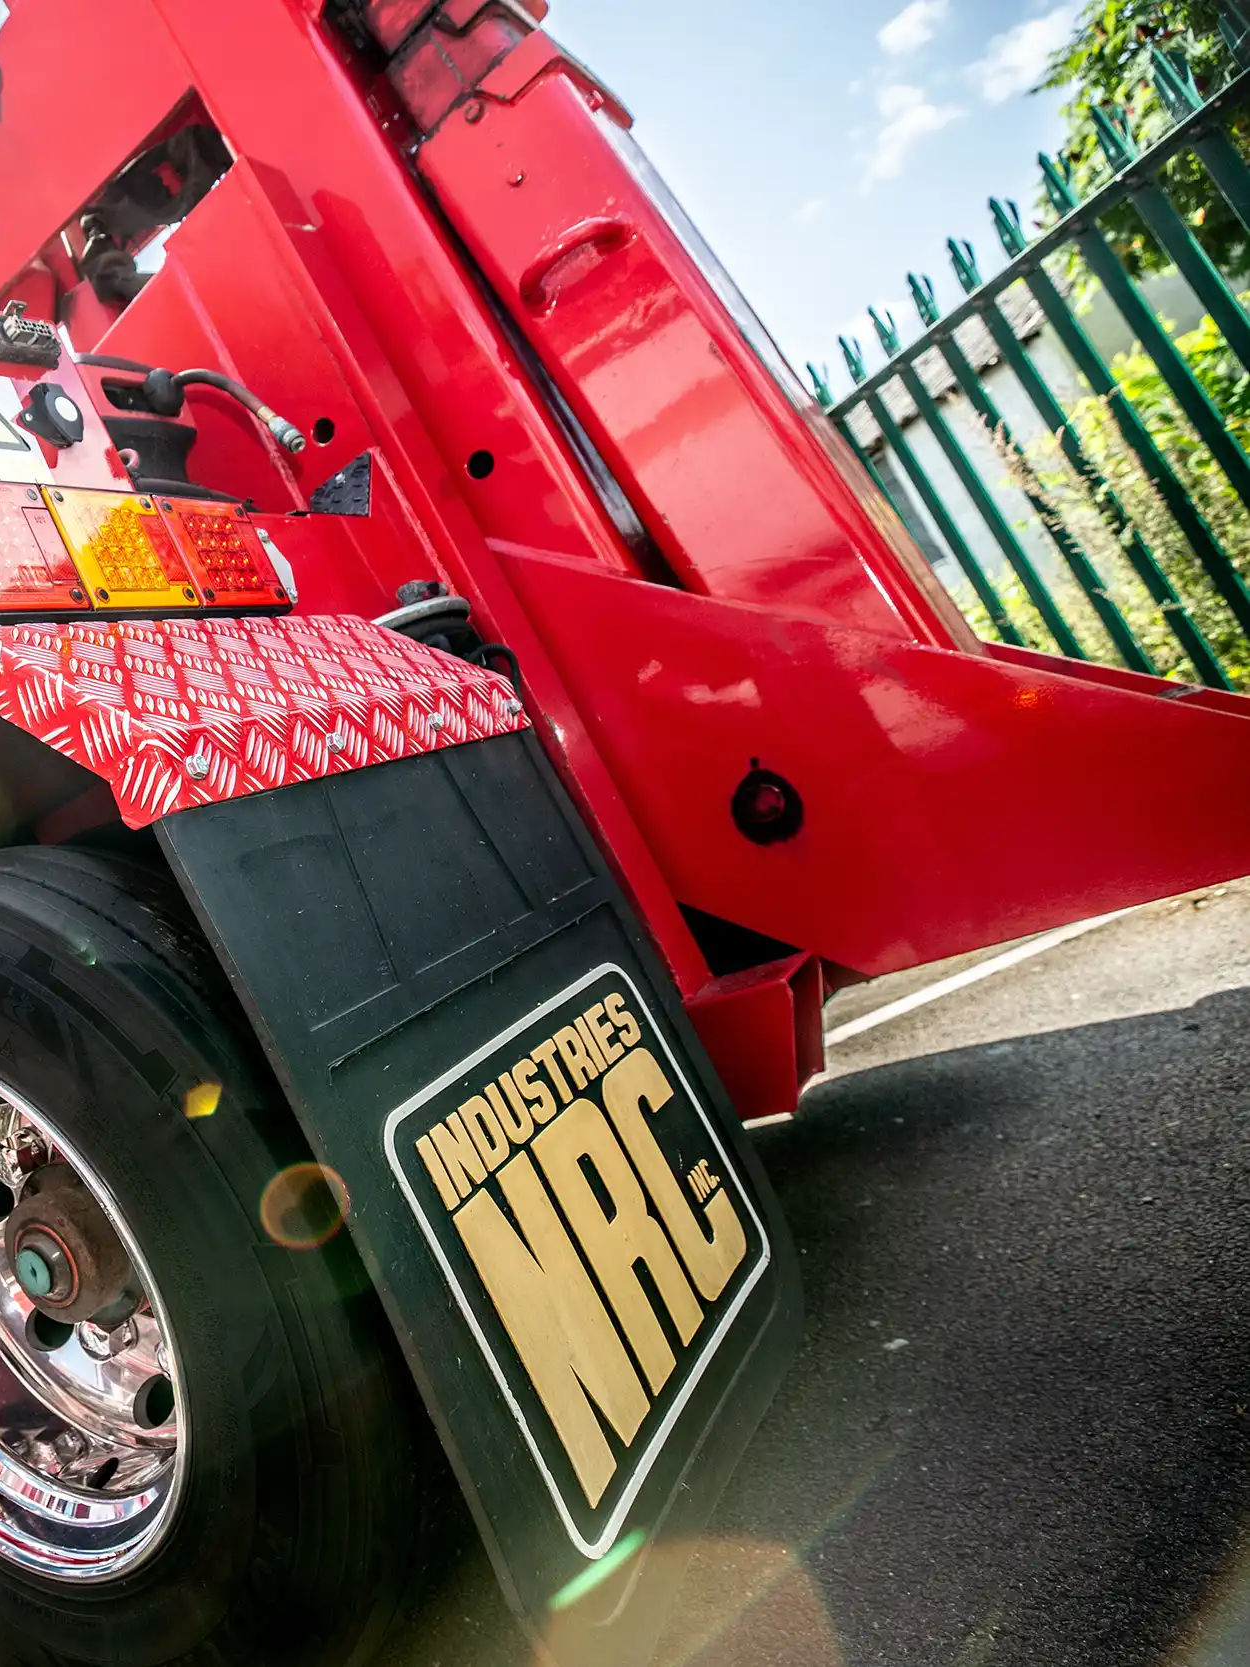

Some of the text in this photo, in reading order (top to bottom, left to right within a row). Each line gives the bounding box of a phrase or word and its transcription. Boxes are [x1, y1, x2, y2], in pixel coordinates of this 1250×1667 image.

[414, 991, 643, 1211] INDUSTRIES
[686, 1158, 721, 1203] INC.
[452, 1047, 748, 1509] NRC
